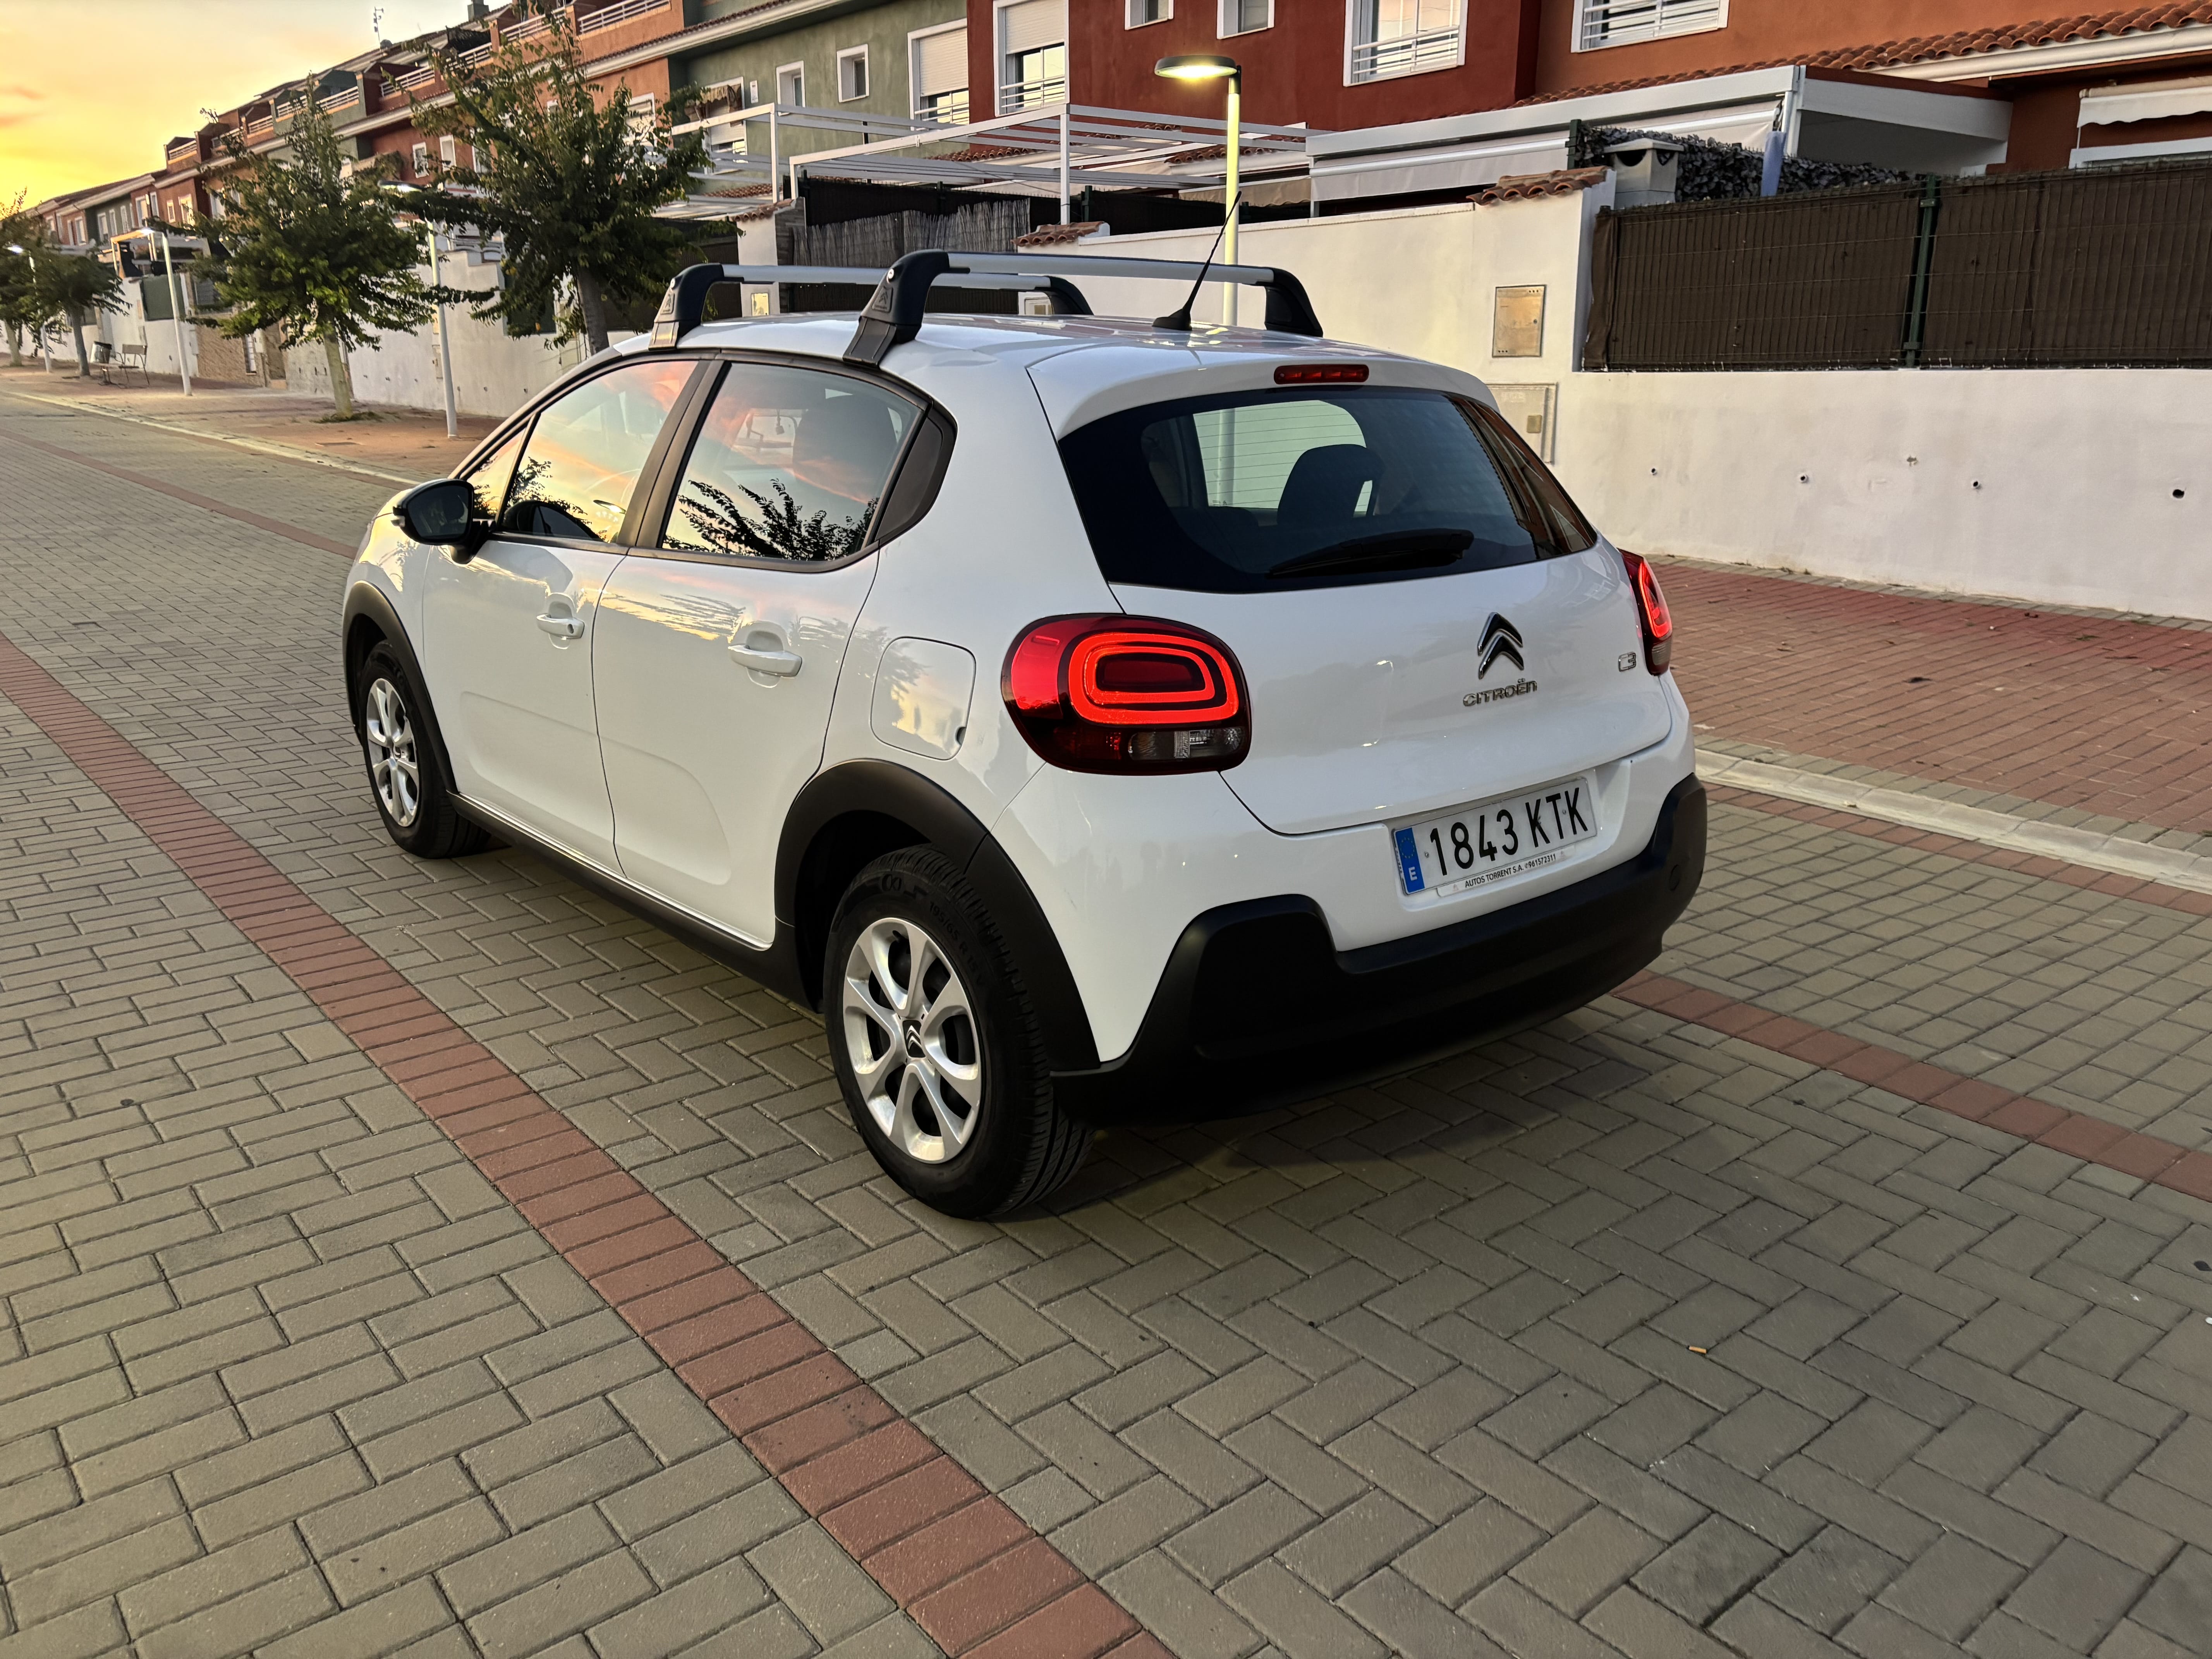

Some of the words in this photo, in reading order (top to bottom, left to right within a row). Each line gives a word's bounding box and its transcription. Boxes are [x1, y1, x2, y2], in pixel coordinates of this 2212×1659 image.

[1618, 652, 1636, 672] C3
[1408, 866, 1417, 881] E
[1430, 809, 1518, 876] 1843
[1525, 787, 1588, 848] KTK
[1465, 876, 1485, 888] AUTOS
[1486, 867, 1512, 881] TORRENT
[1513, 864, 1524, 873] S.A.
[1528, 853, 1556, 868] 961572311
[930, 901, 961, 941] 195/65
